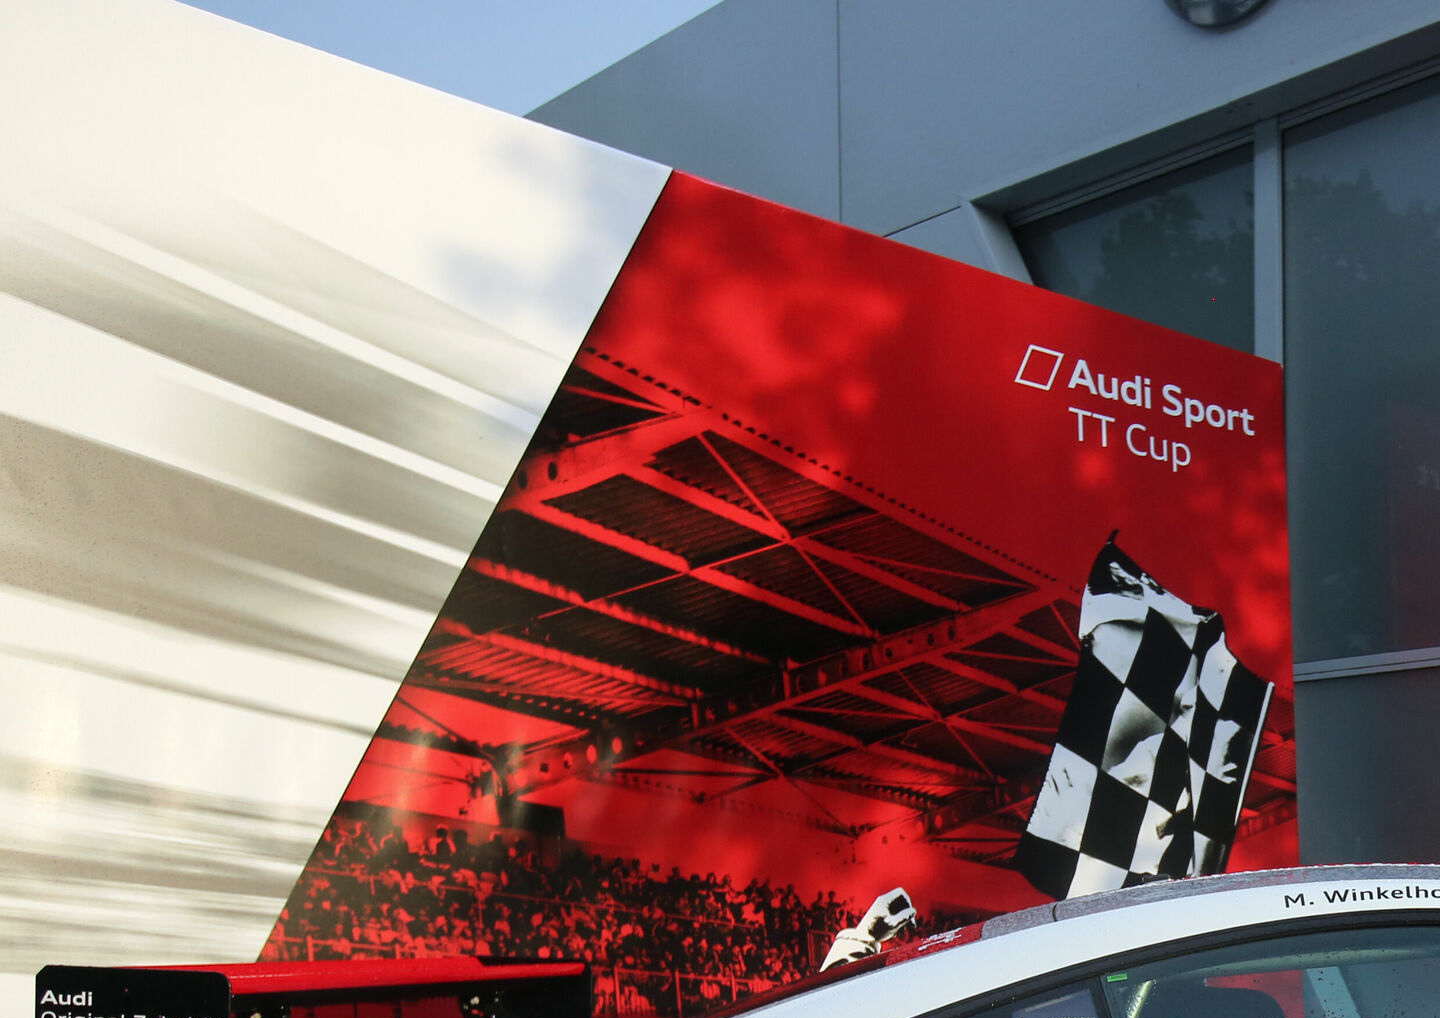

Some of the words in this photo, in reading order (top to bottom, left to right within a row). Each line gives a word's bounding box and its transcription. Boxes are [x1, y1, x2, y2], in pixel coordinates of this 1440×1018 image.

[1067, 359, 1152, 409] Audi
[1161, 383, 1256, 437] Sport
[1068, 406, 1116, 448] TT
[1125, 422, 1192, 473] Cup
[1283, 893, 1315, 909] M.
[40, 989, 93, 1007] Audi
